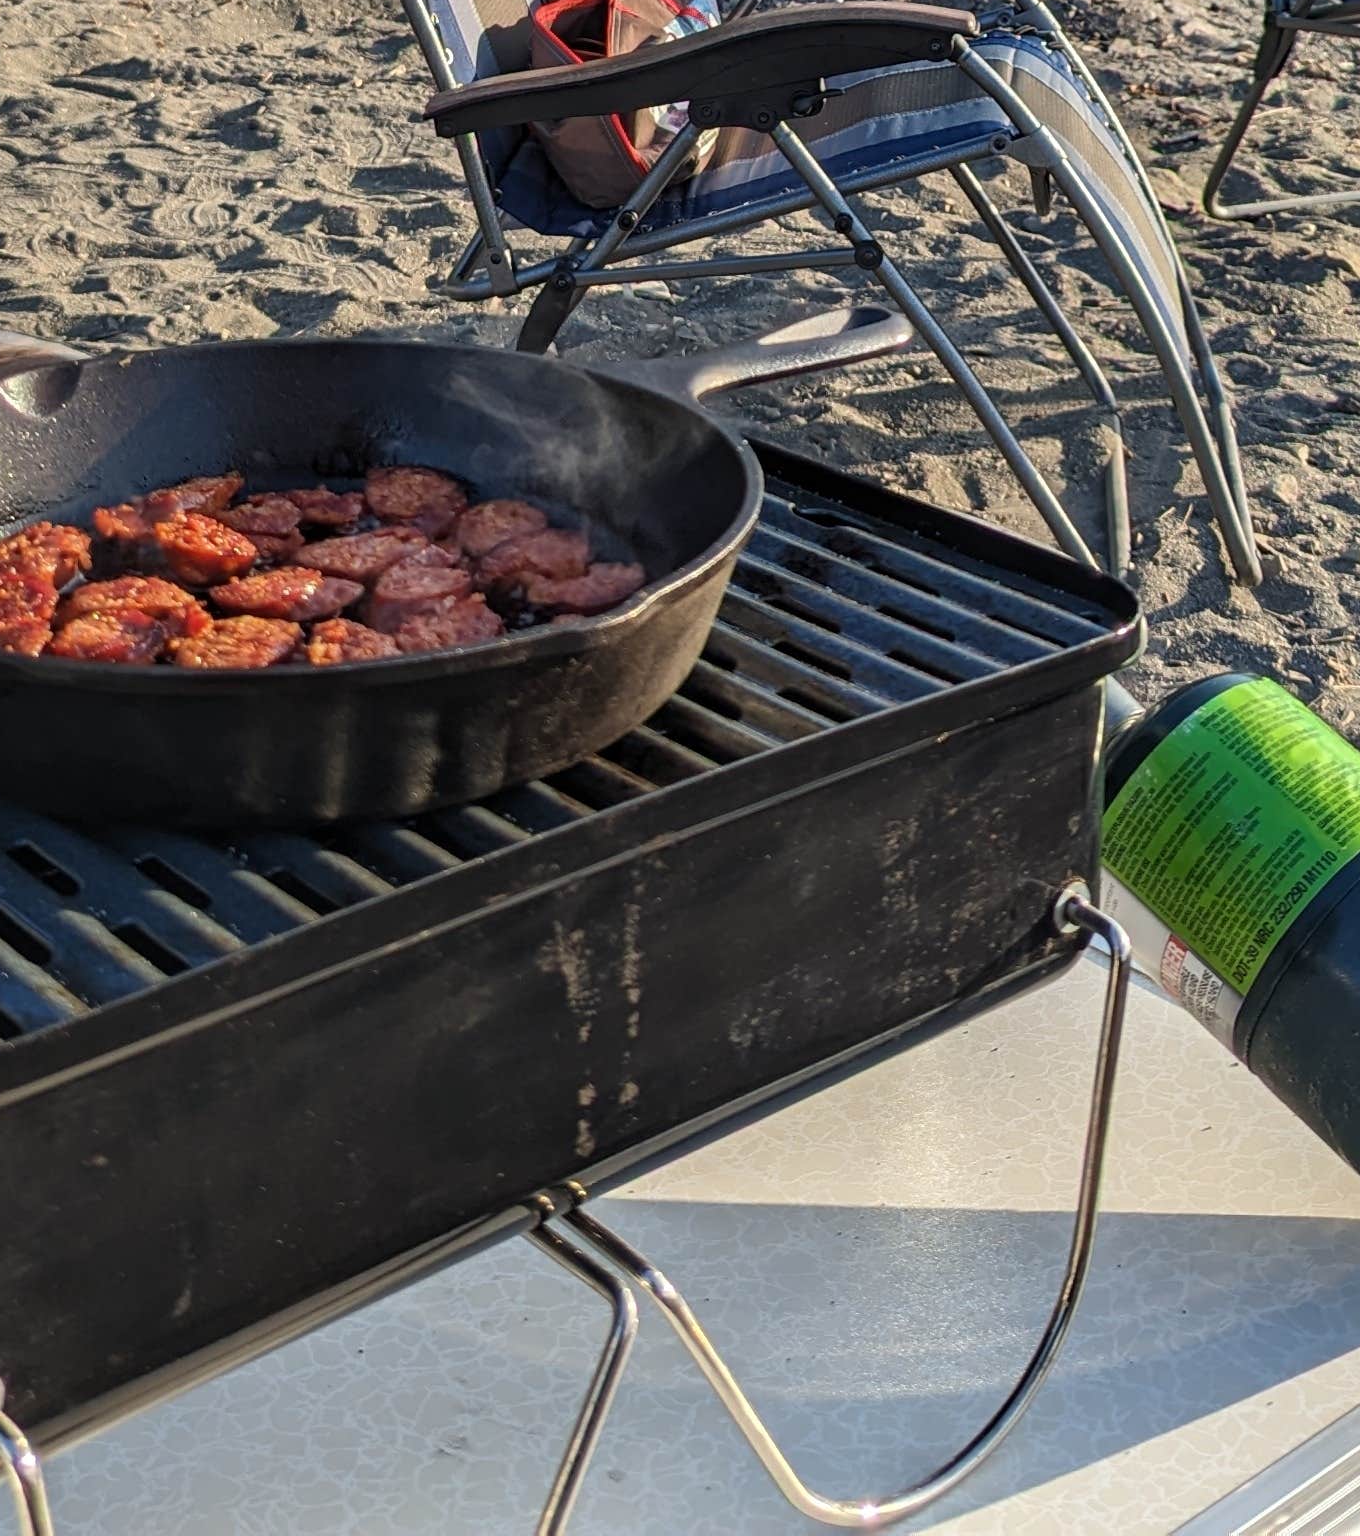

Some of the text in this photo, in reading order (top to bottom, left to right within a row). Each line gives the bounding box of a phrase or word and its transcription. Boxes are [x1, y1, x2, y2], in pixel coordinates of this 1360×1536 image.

[1231, 850, 1338, 984] DOT-39 NRC 232/290 M1110
